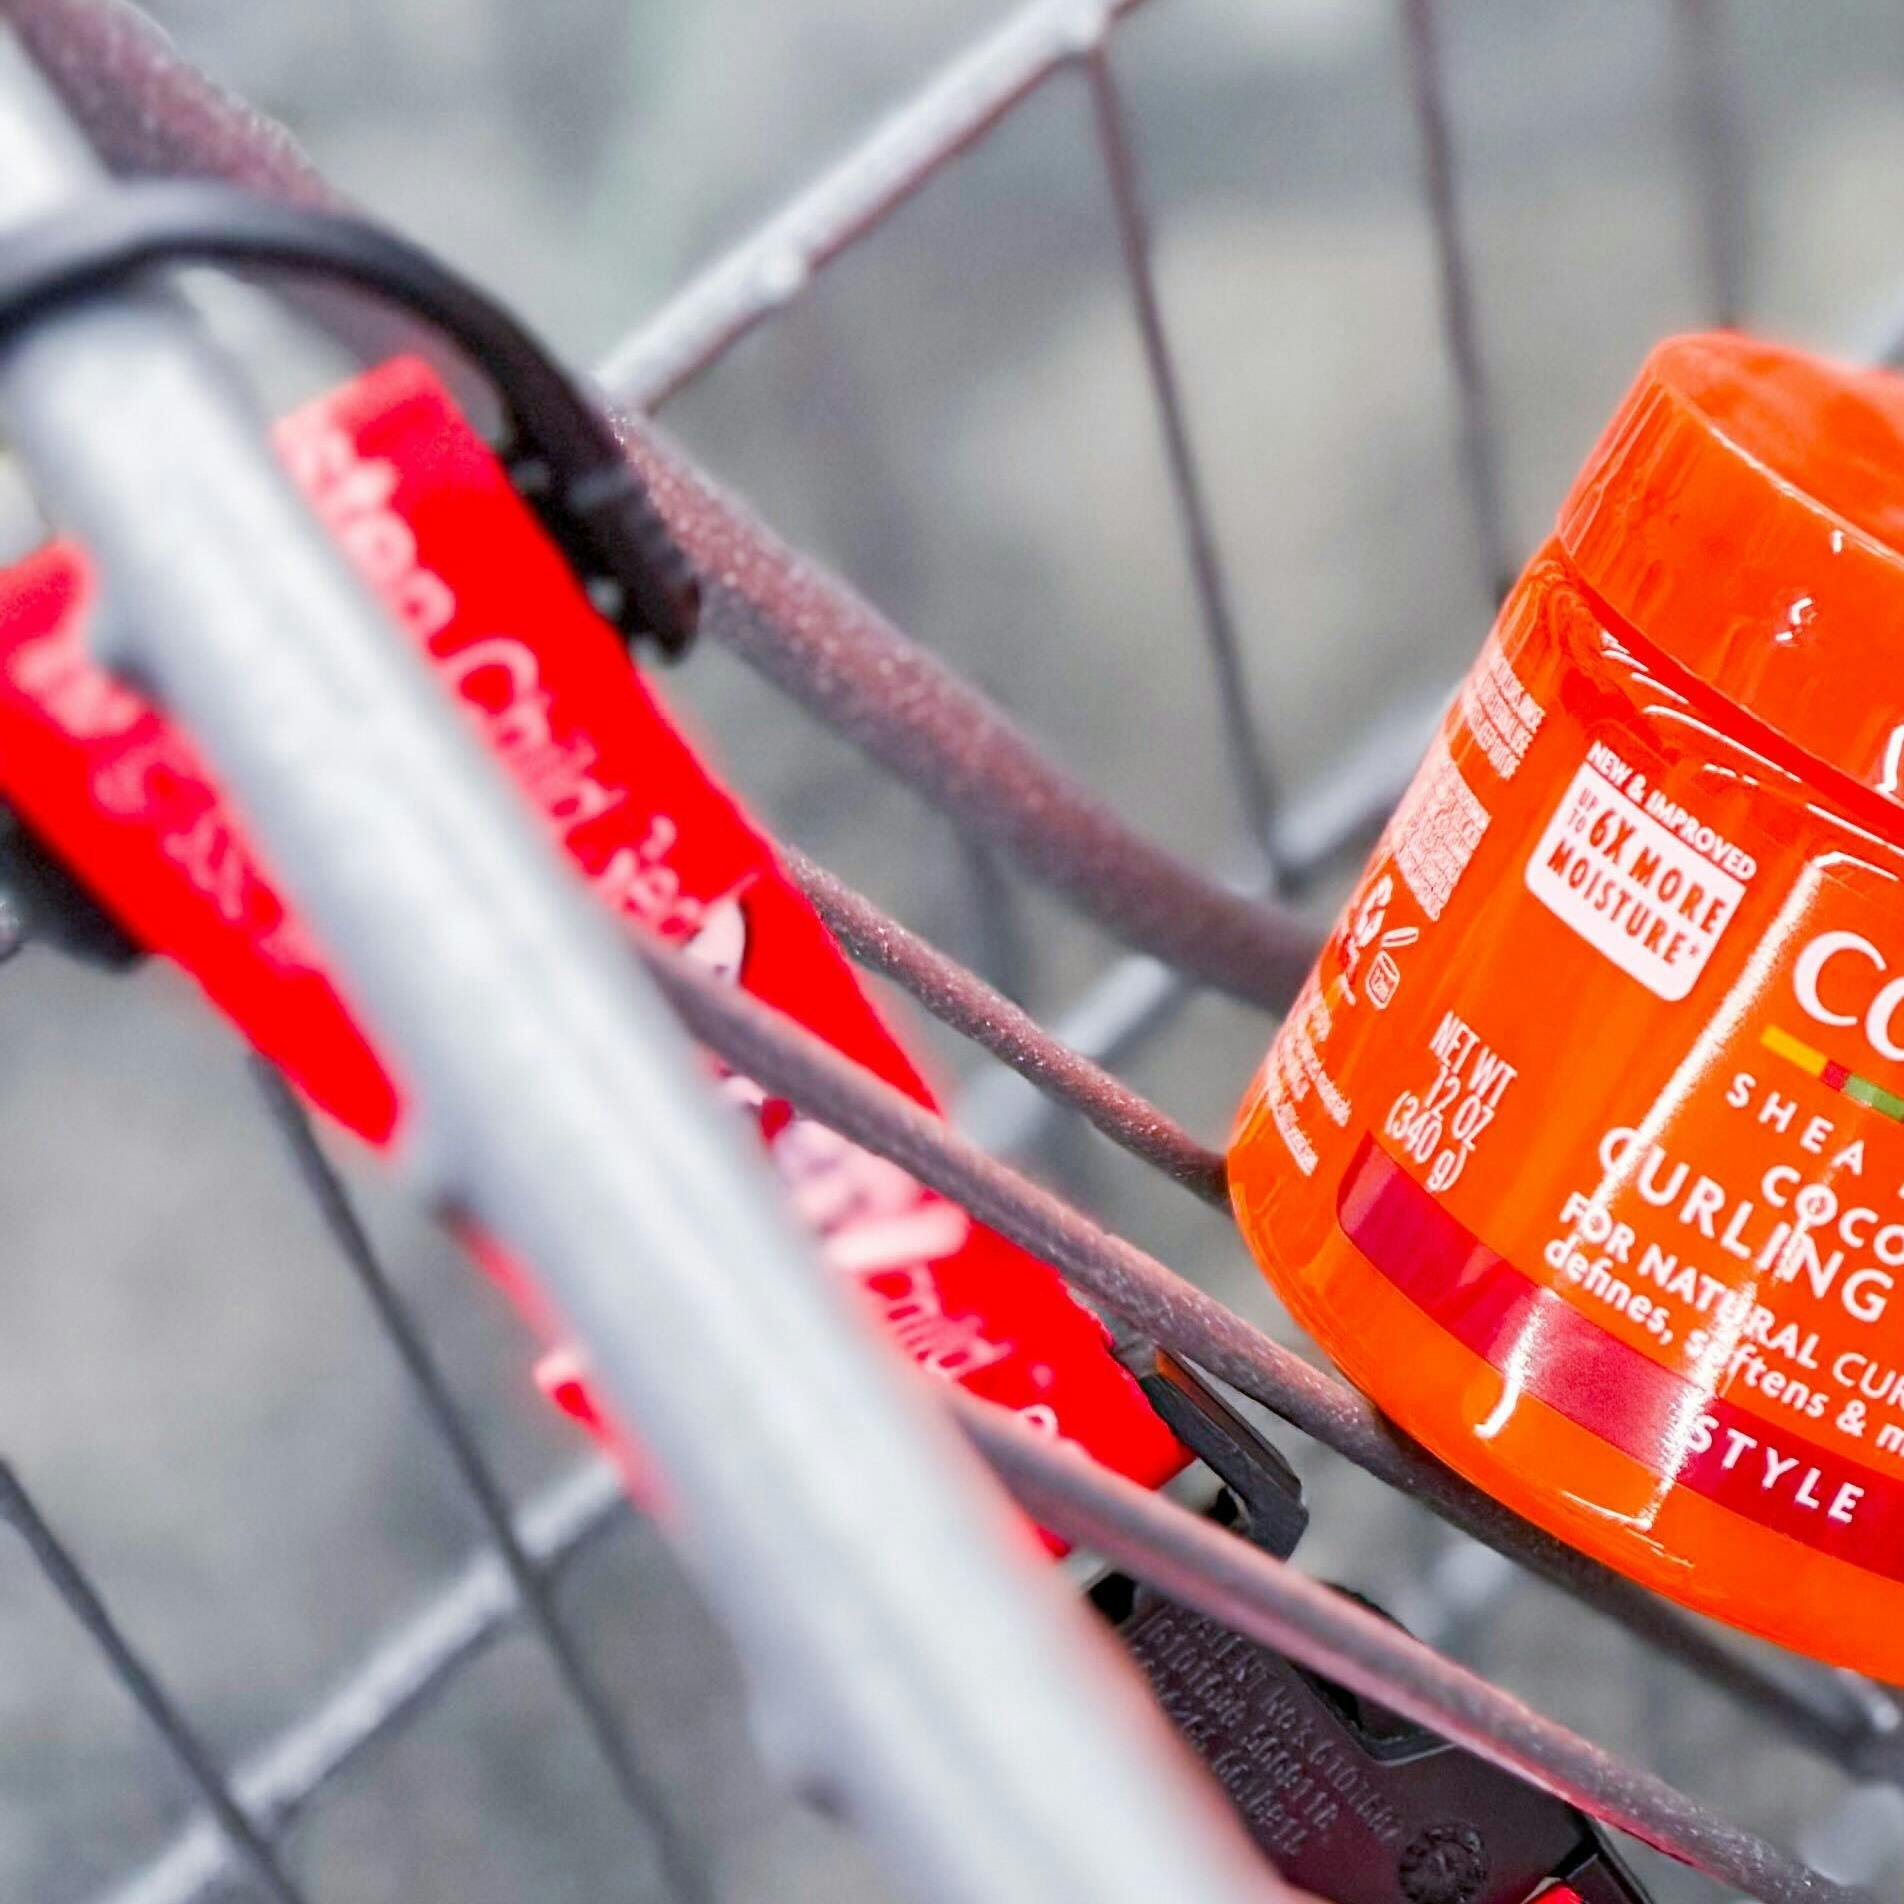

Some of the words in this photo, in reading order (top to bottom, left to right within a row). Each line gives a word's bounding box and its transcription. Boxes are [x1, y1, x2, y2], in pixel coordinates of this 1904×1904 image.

[1586, 739, 1633, 787] NEW
[1625, 773, 1647, 802] &
[1643, 789, 1758, 881] IMPROVED
[1589, 807, 1637, 867] 6X
[1629, 846, 1727, 936] MORE
[1424, 1064, 1462, 1122] 12
[1452, 1094, 1496, 1152] OZ
[1429, 1010, 1480, 1074] NET
[1468, 1046, 1518, 1109] WT
[1725, 1072, 1866, 1176] SHEA
[1559, 1191, 1636, 1264] FOR
[1637, 1243, 1819, 1370] NATURAL
[1598, 1126, 1894, 1324] CURLING
[1543, 1234, 1674, 1345] defines,
[1836, 1399, 1867, 1438] &
[1686, 1414, 1867, 1525] STYLE
